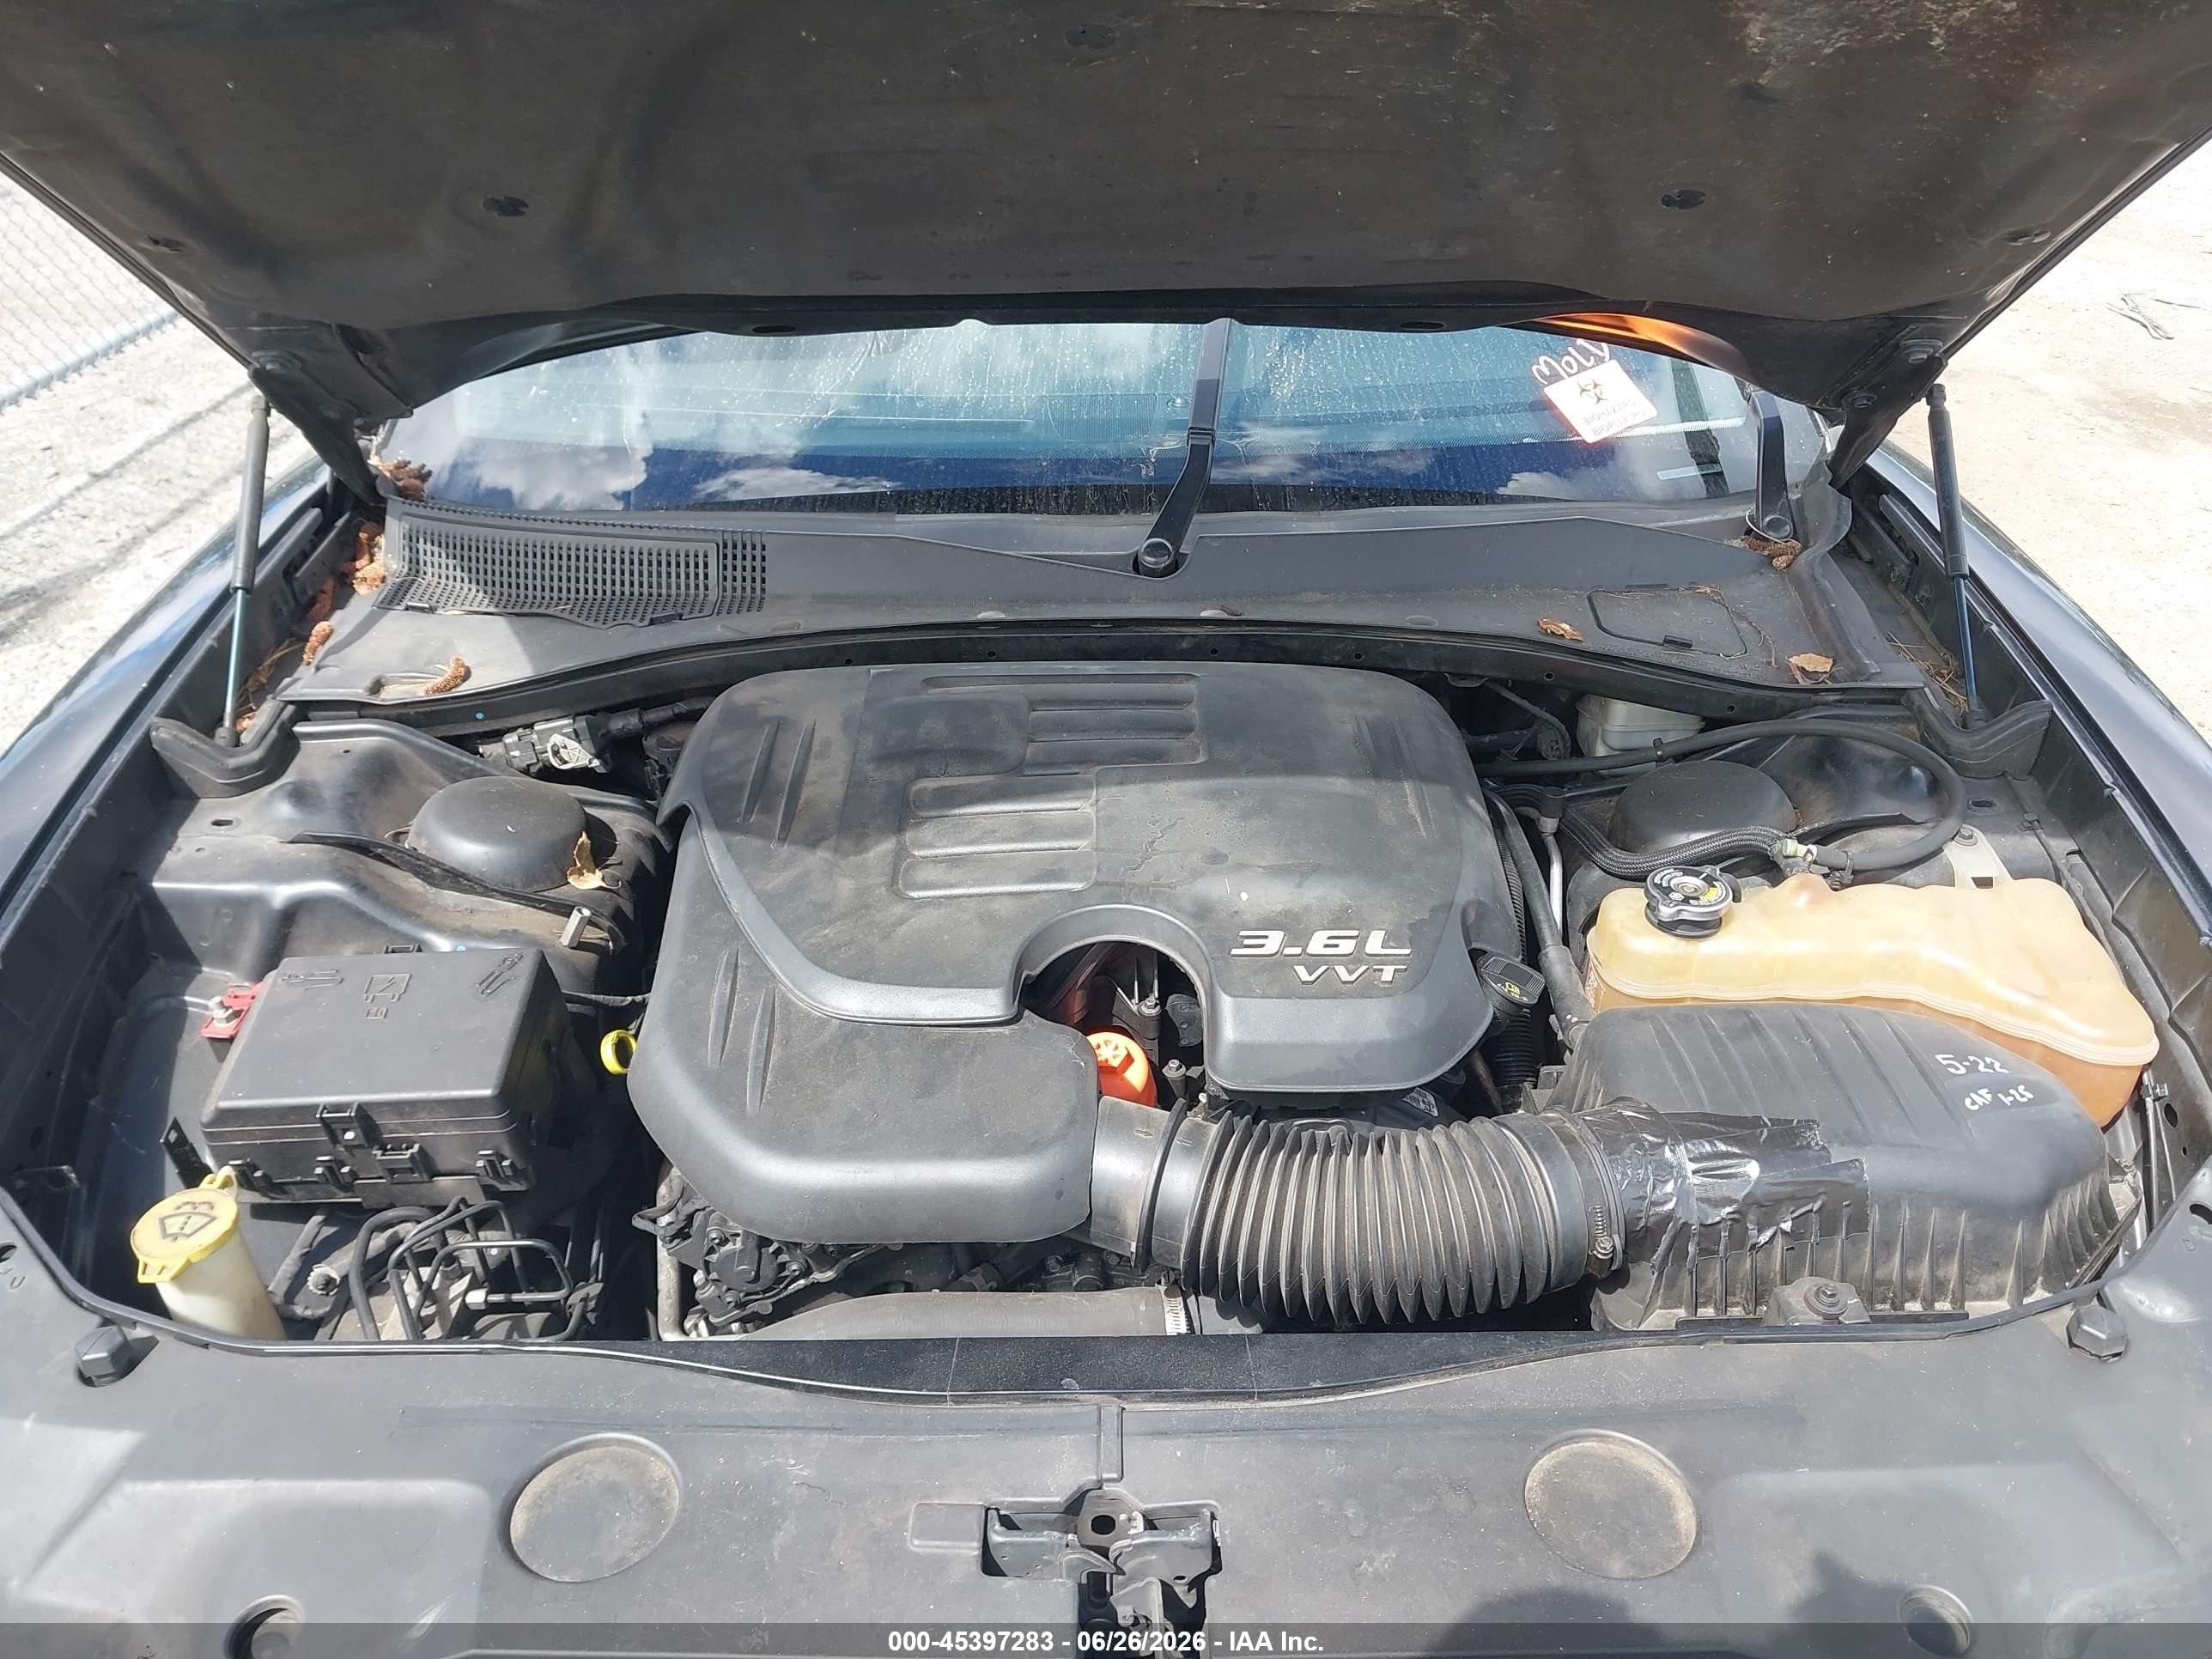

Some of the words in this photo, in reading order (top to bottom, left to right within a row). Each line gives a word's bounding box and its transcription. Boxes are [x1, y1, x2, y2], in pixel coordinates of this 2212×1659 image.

[1230, 930, 1412, 957] 3.6L
[1292, 964, 1408, 985] VVT
[1934, 1054, 2010, 1075] 5-22
